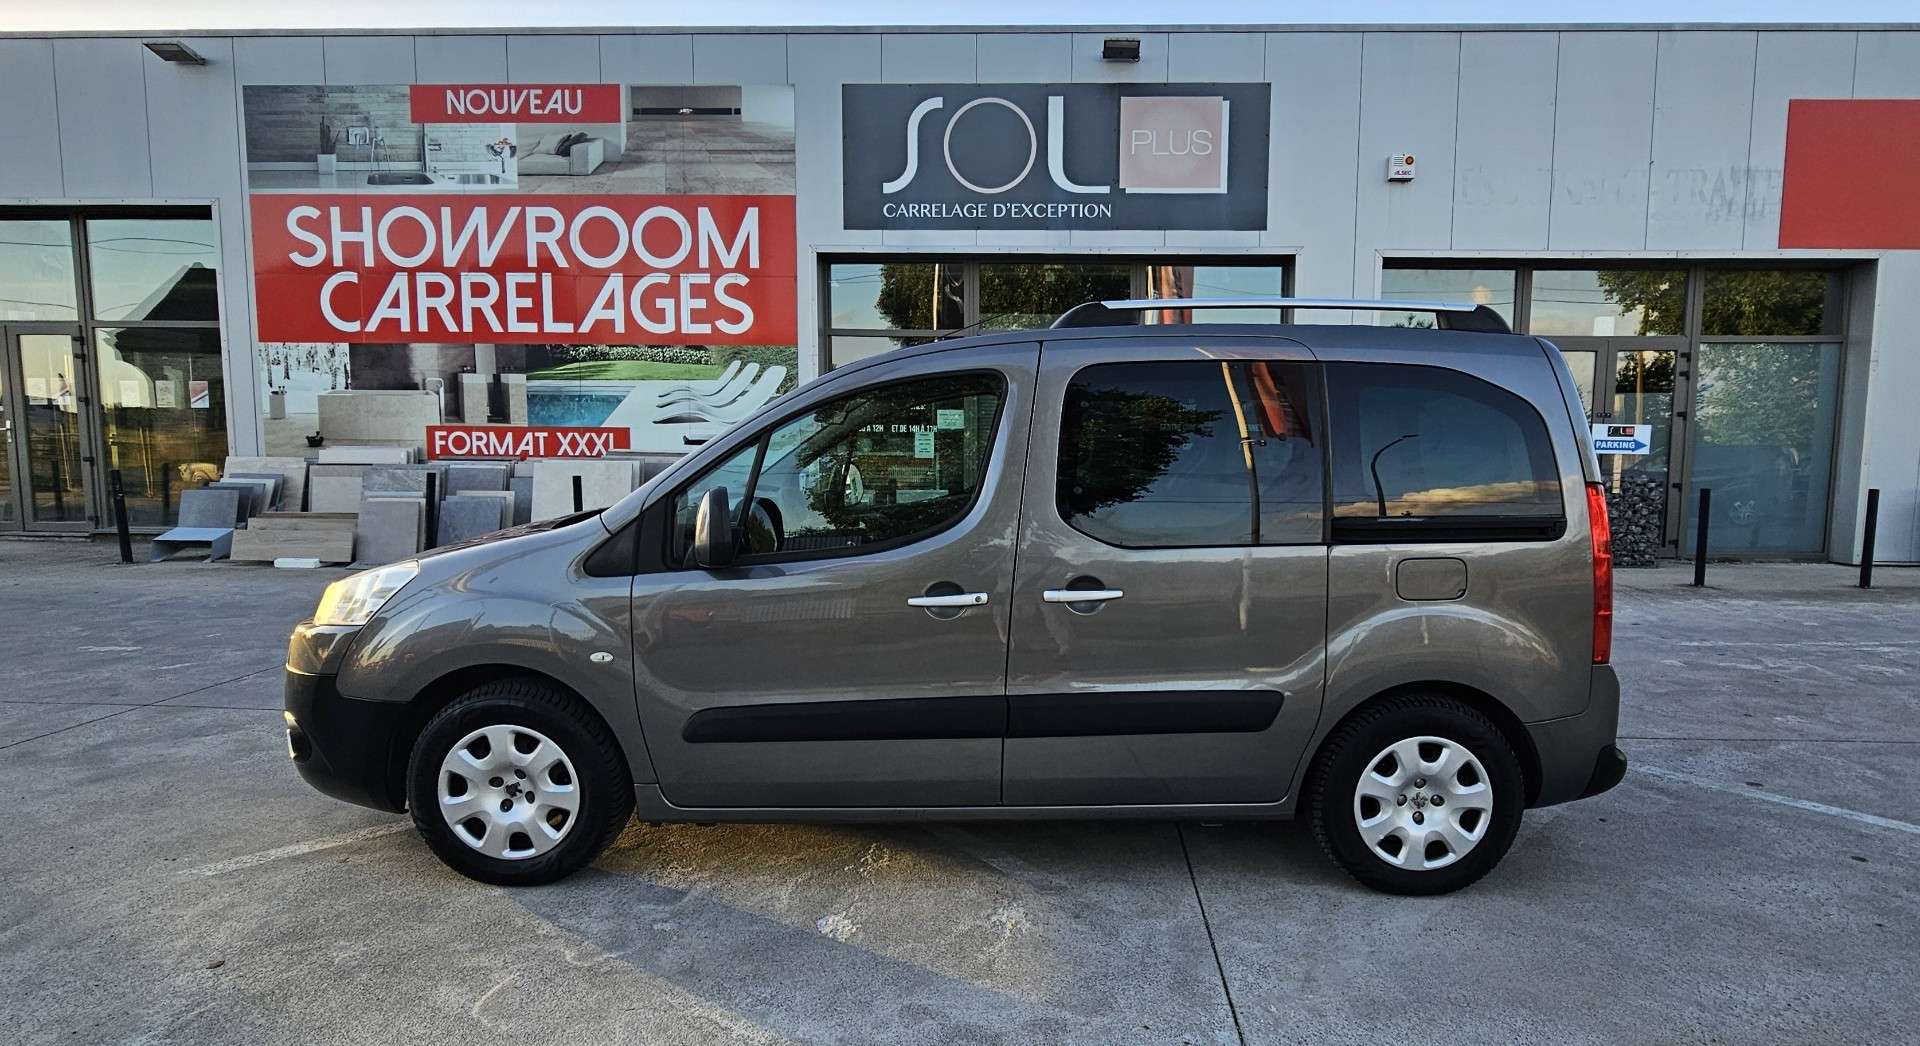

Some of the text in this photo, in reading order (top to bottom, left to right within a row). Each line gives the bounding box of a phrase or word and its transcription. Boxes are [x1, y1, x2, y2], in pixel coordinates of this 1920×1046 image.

[446, 89, 583, 115] NOUVEAU
[882, 95, 1111, 195] SOL
[1130, 129, 1213, 156] PLUS
[882, 203, 1112, 219] CARRELAGE D'EXCEPTION
[286, 205, 760, 269] SHOWROOM
[319, 271, 755, 335] CARRELAGES
[872, 424, 884, 433] 12H
[891, 424, 898, 433] ET
[899, 424, 907, 433] DE
[434, 431, 549, 456] FORMAT
[1595, 440, 1636, 449] PARKING
